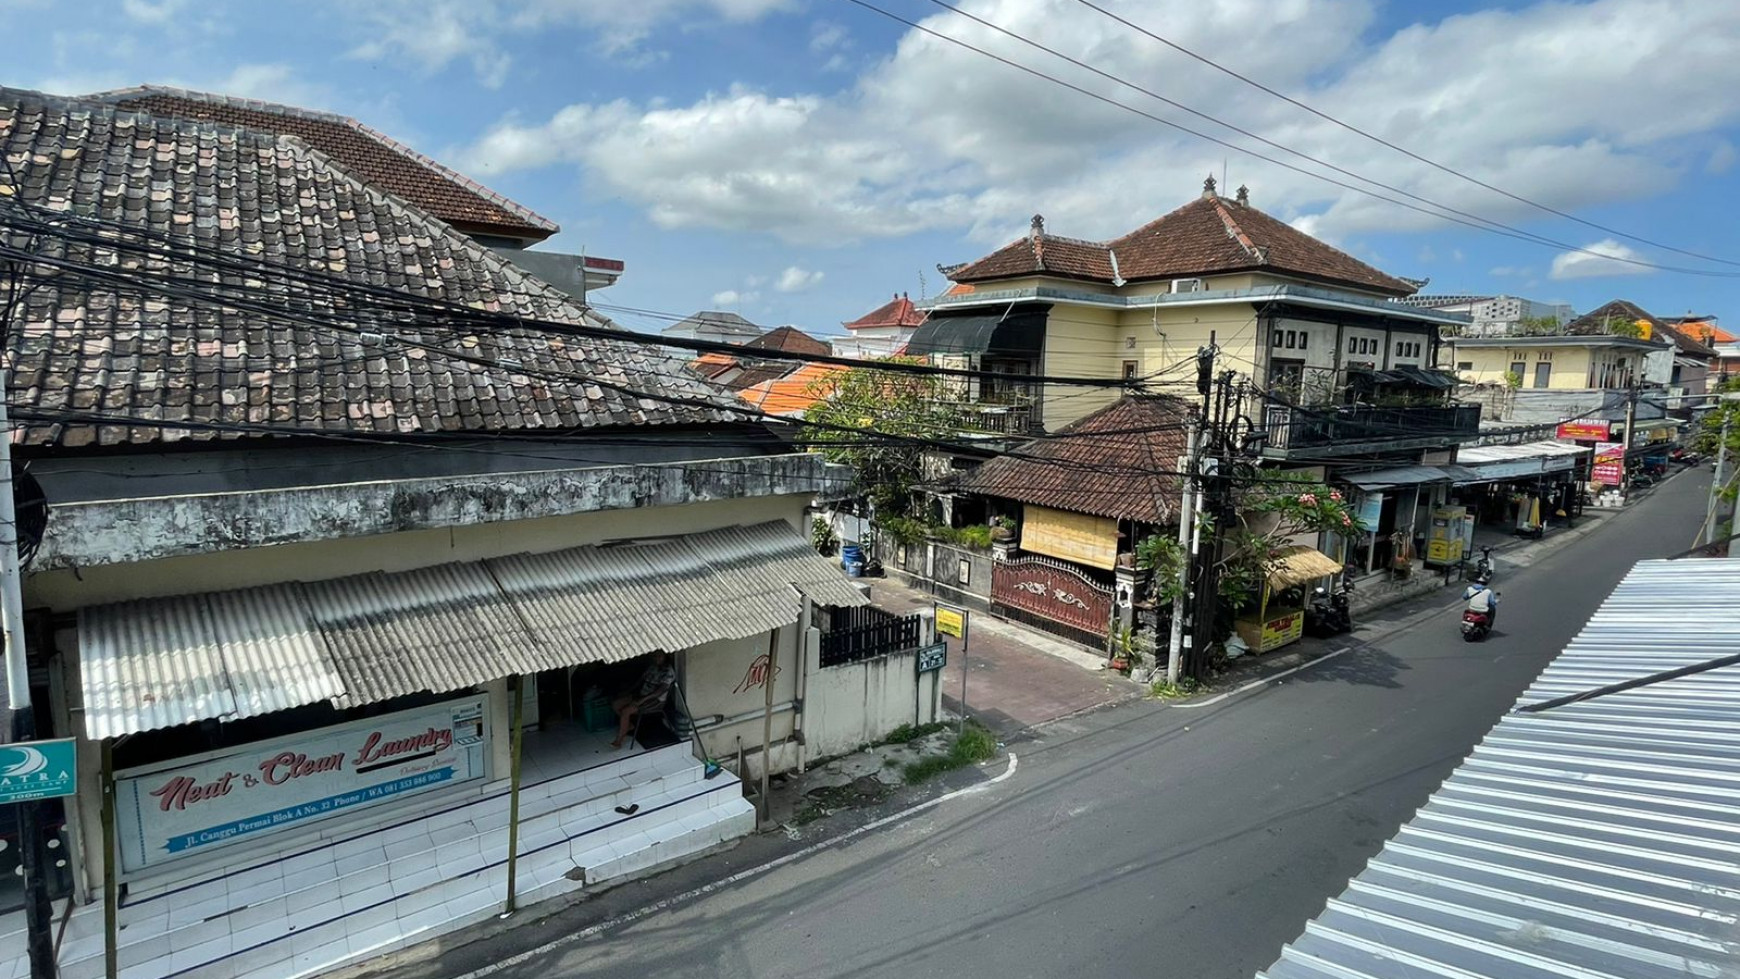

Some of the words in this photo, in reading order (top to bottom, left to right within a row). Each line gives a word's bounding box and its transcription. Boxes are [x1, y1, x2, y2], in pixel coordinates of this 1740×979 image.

[149, 772, 240, 811] Neat
[243, 774, 259, 788] &
[259, 752, 345, 785] Clean
[352, 728, 453, 765] Laundry
[200, 828, 237, 841] Canggu
[239, 815, 271, 831] Permai
[273, 811, 293, 824] Blok
[295, 808, 302, 817] A
[304, 806, 319, 815] No.
[334, 795, 360, 806] Phone
[369, 787, 383, 797] WA
